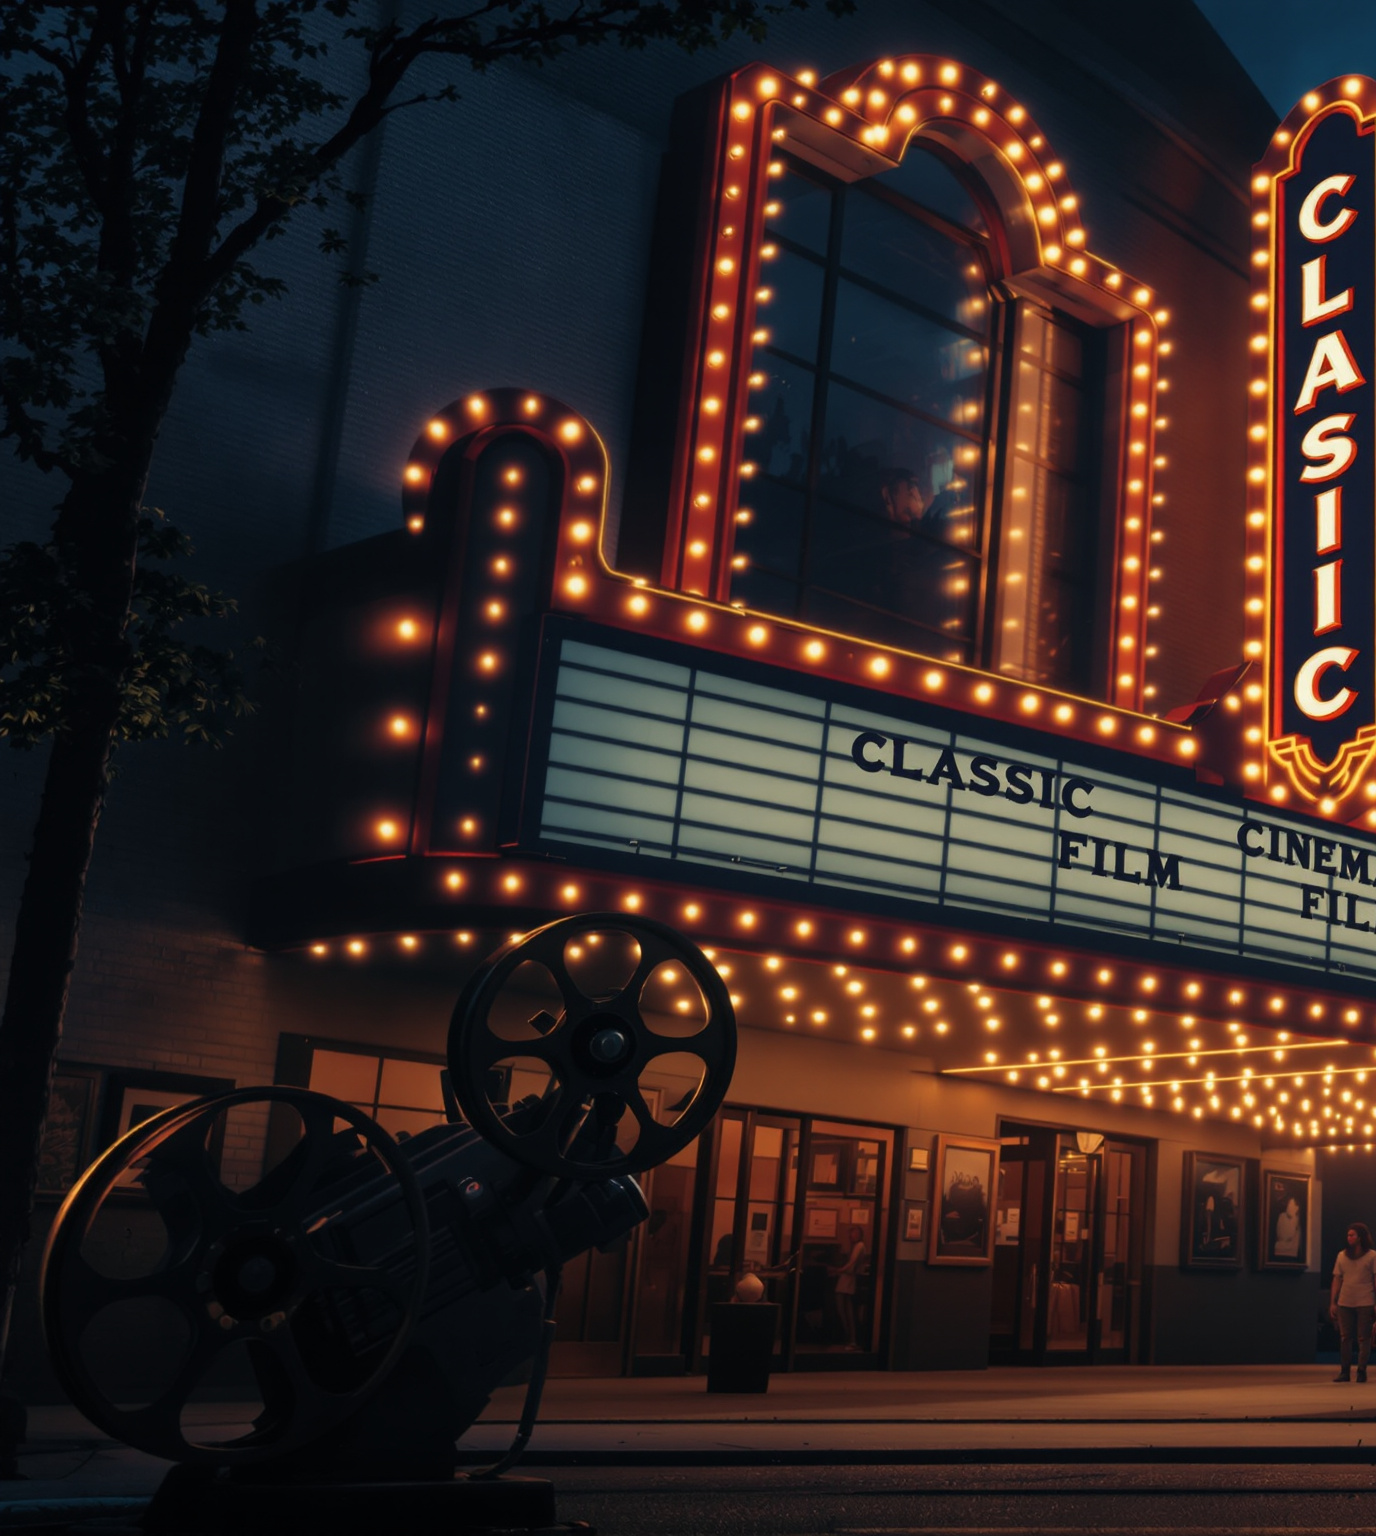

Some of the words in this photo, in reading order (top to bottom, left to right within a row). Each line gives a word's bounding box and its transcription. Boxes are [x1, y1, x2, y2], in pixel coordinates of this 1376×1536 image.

[1294, 173, 1366, 722] CLASIIC
[851, 731, 1095, 818] CLASSIC
[1058, 830, 1184, 891] FILM
